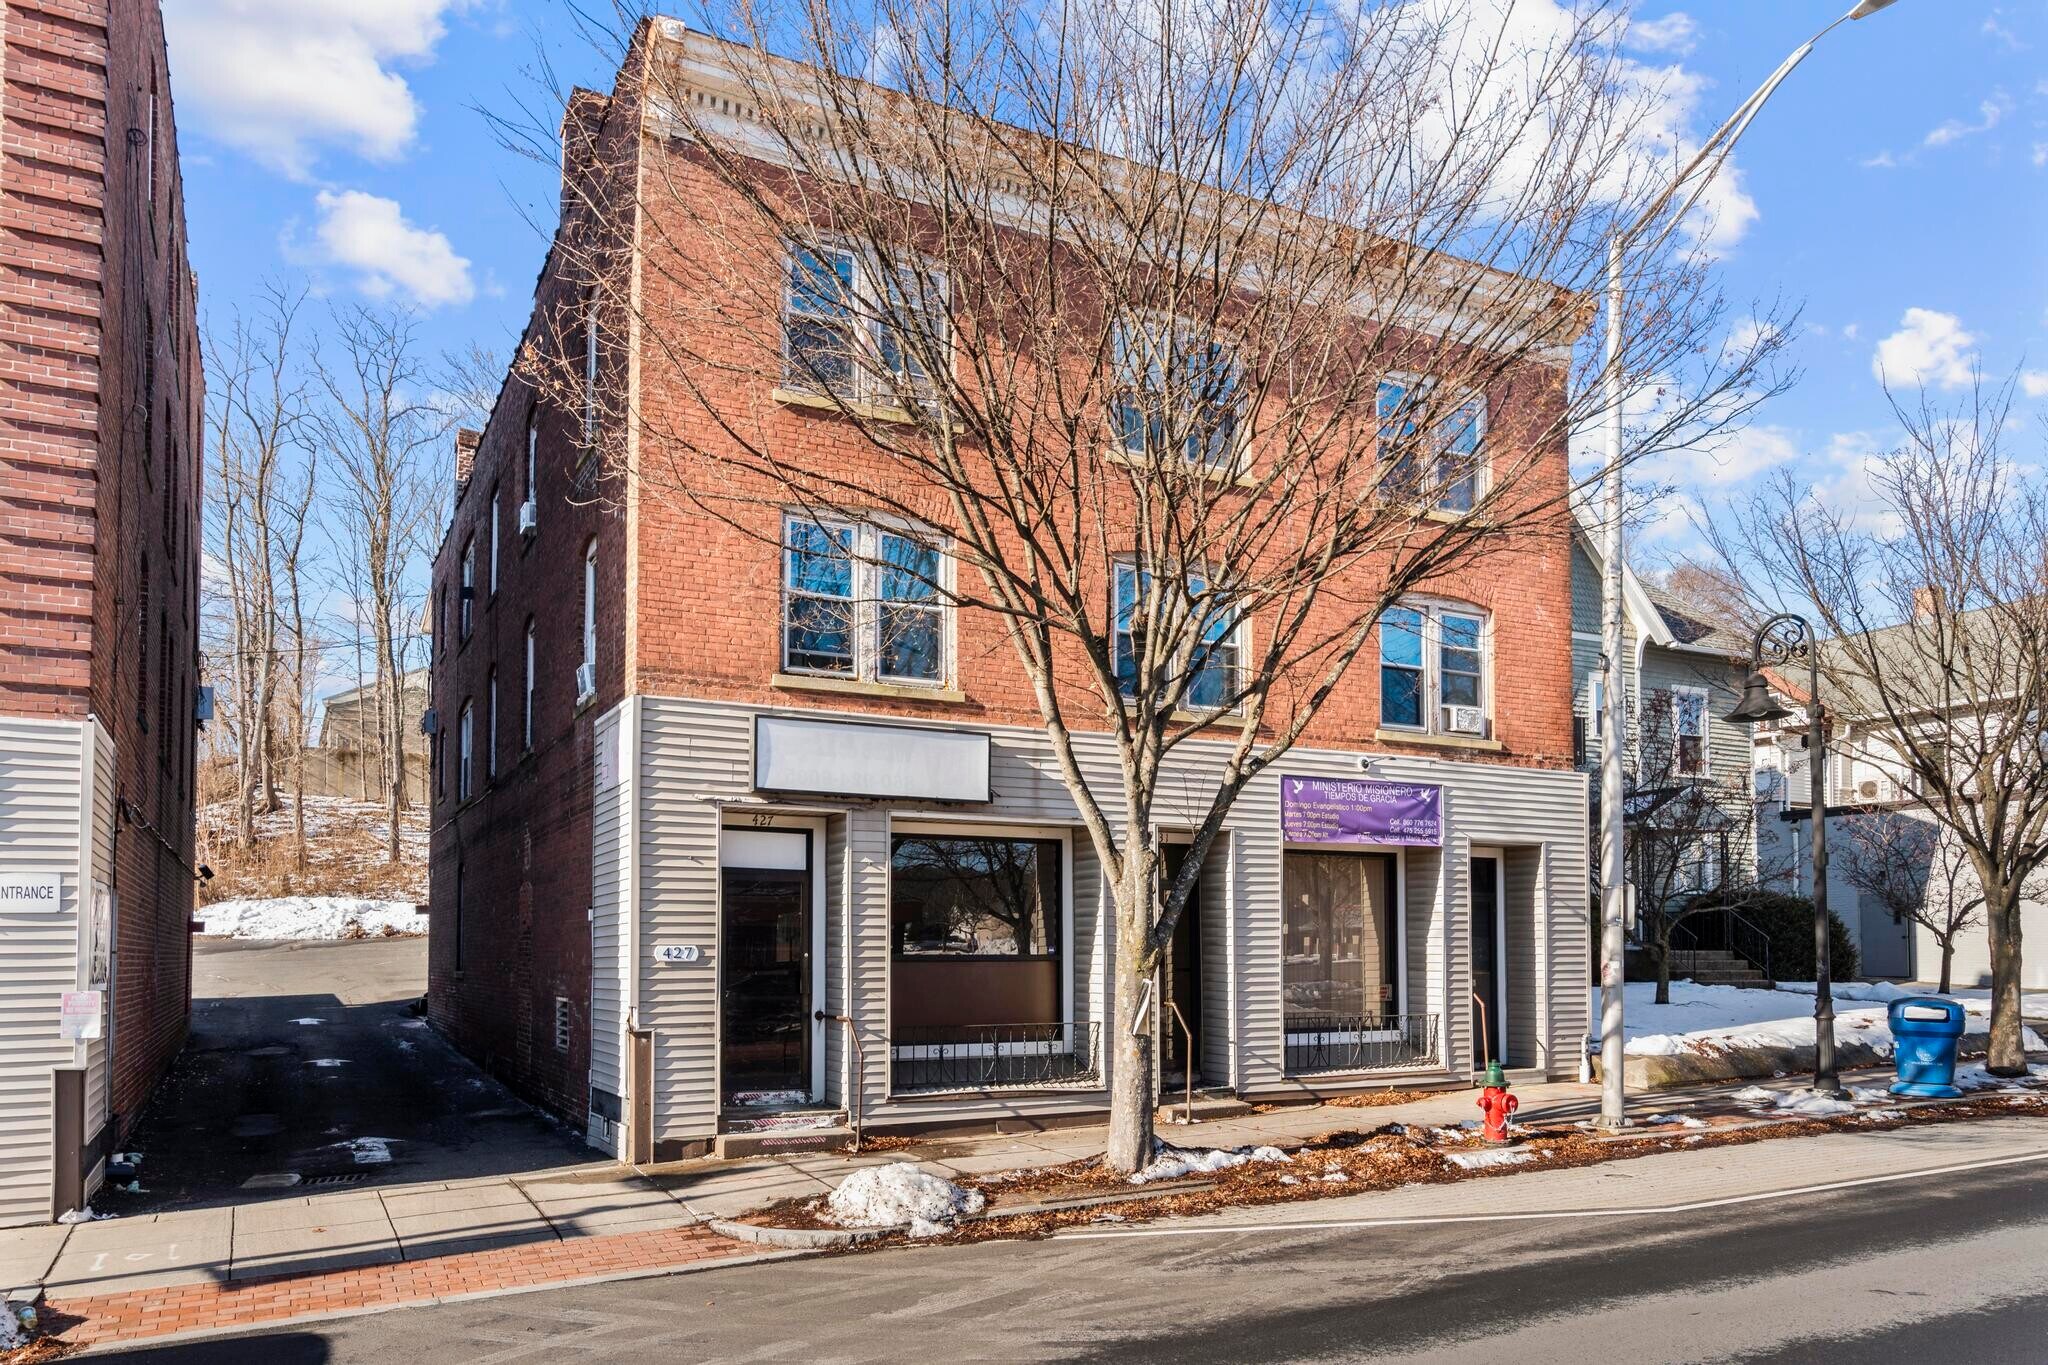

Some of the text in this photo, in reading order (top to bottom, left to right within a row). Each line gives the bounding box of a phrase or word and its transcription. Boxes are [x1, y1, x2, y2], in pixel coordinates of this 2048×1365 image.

[1312, 780, 1413, 797] MINISTERIO MISIONERO
[1324, 791, 1397, 804] TIEMPOS DE GRACIA
[752, 814, 774, 826] 427
[1, 886, 54, 899] NTRANCE
[662, 947, 693, 960] 427
